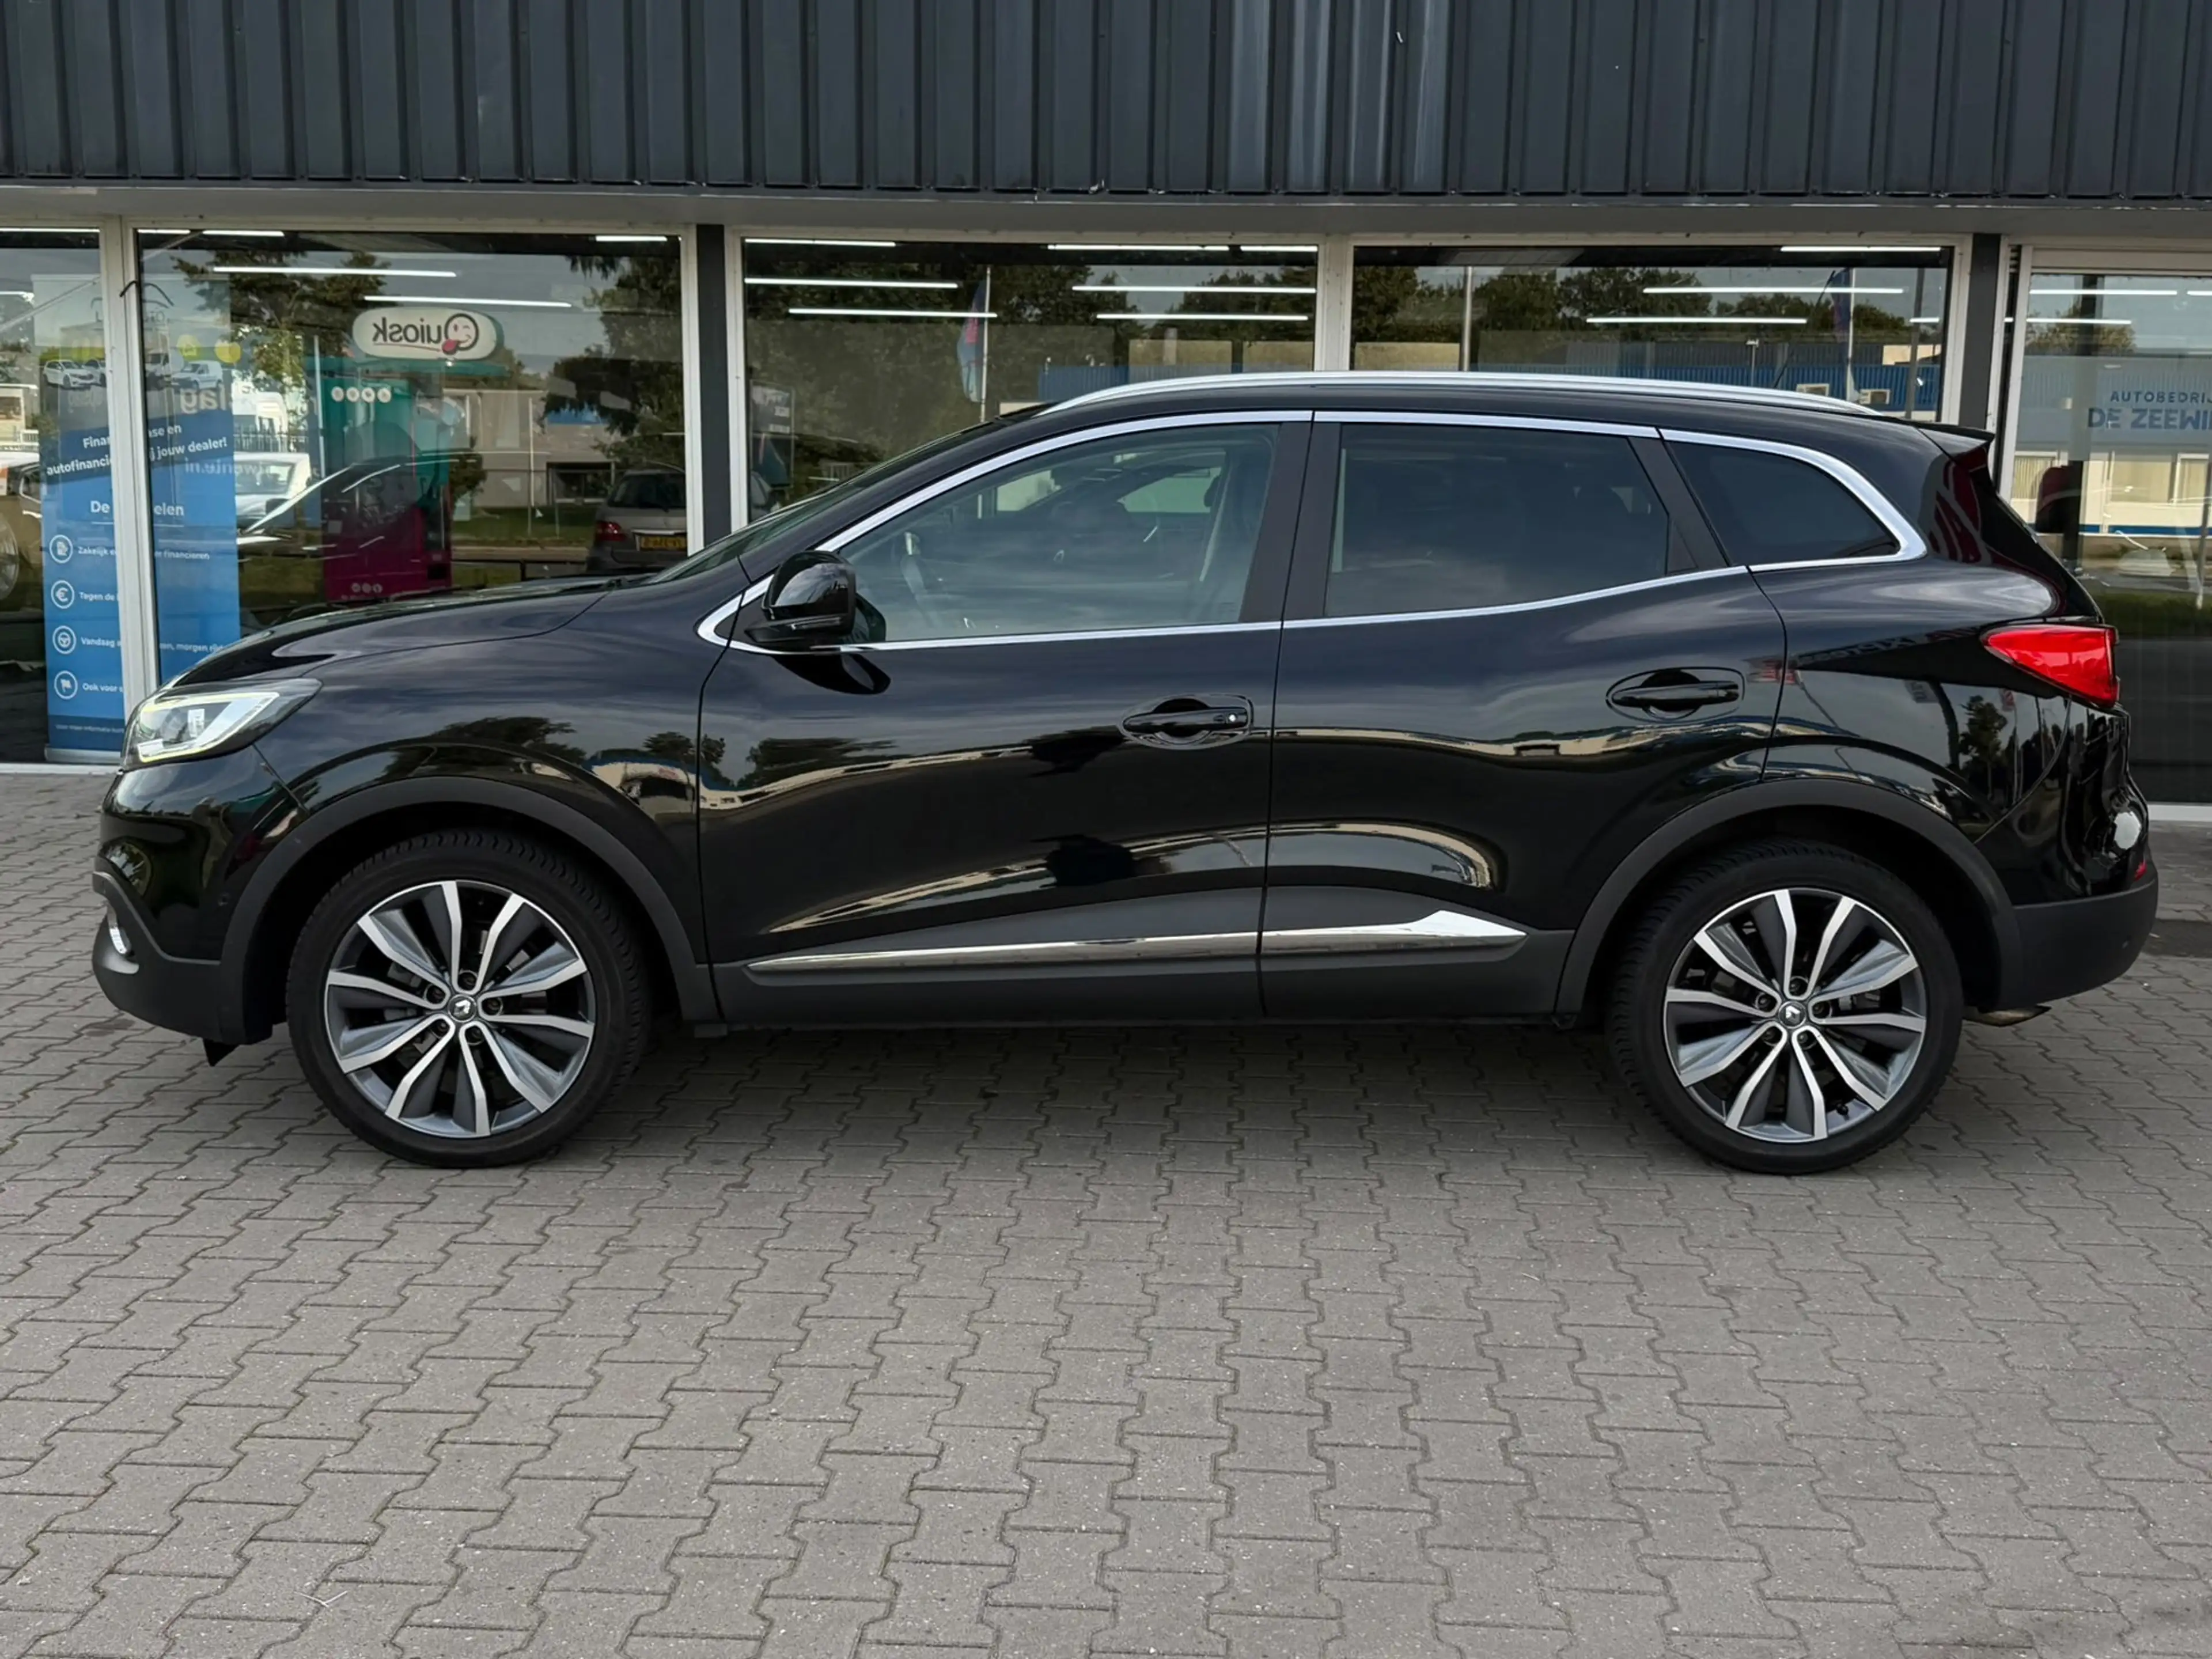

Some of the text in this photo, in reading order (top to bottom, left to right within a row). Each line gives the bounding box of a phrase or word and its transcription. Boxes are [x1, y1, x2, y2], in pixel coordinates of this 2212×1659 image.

[2088, 407, 2212, 431] DE ZEEWI
[167, 424, 182, 435] en
[46, 454, 111, 476] autofinanci
[157, 445, 185, 460] jouw
[187, 435, 228, 453] dealer!
[90, 500, 184, 516] De elen
[80, 636, 115, 649] Vandaag
[81, 682, 99, 692] Ook
